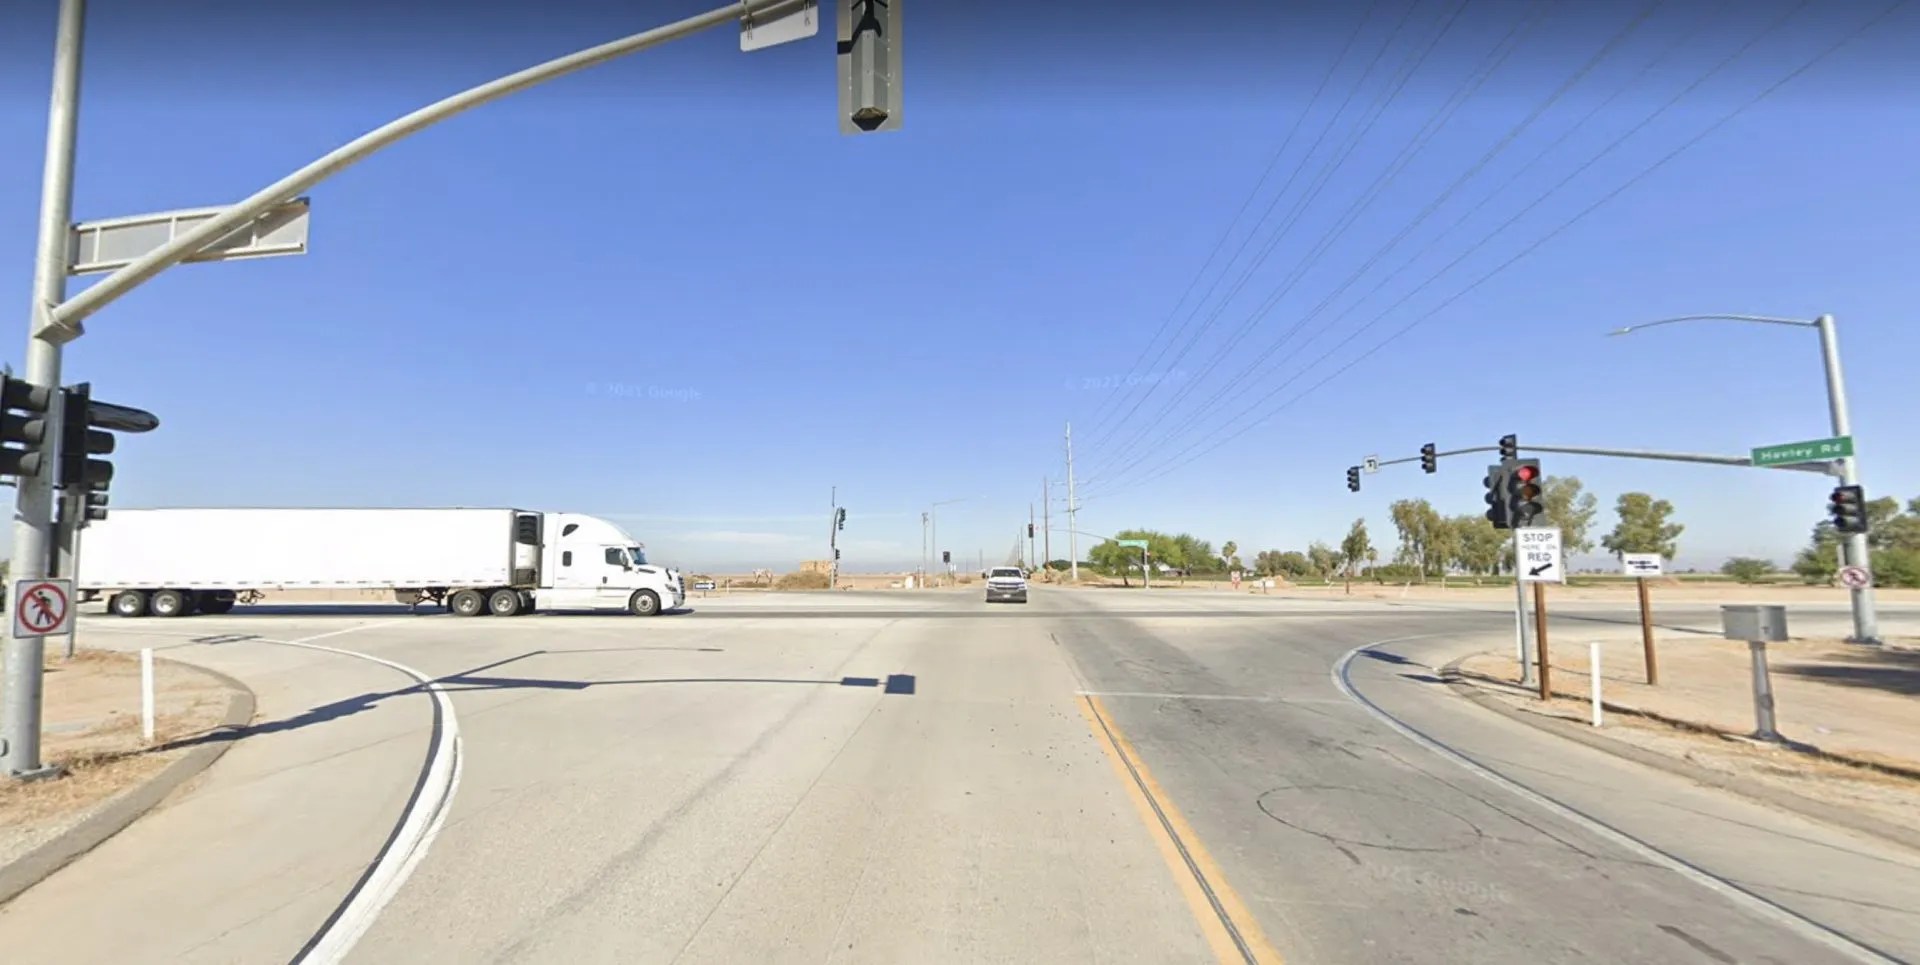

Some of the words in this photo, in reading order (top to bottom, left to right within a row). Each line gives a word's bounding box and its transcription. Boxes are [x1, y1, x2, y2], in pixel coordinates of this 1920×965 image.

[1820, 443, 1842, 454] Rd
[1522, 532, 1554, 543] STOP
[1527, 551, 1553, 562] RED
